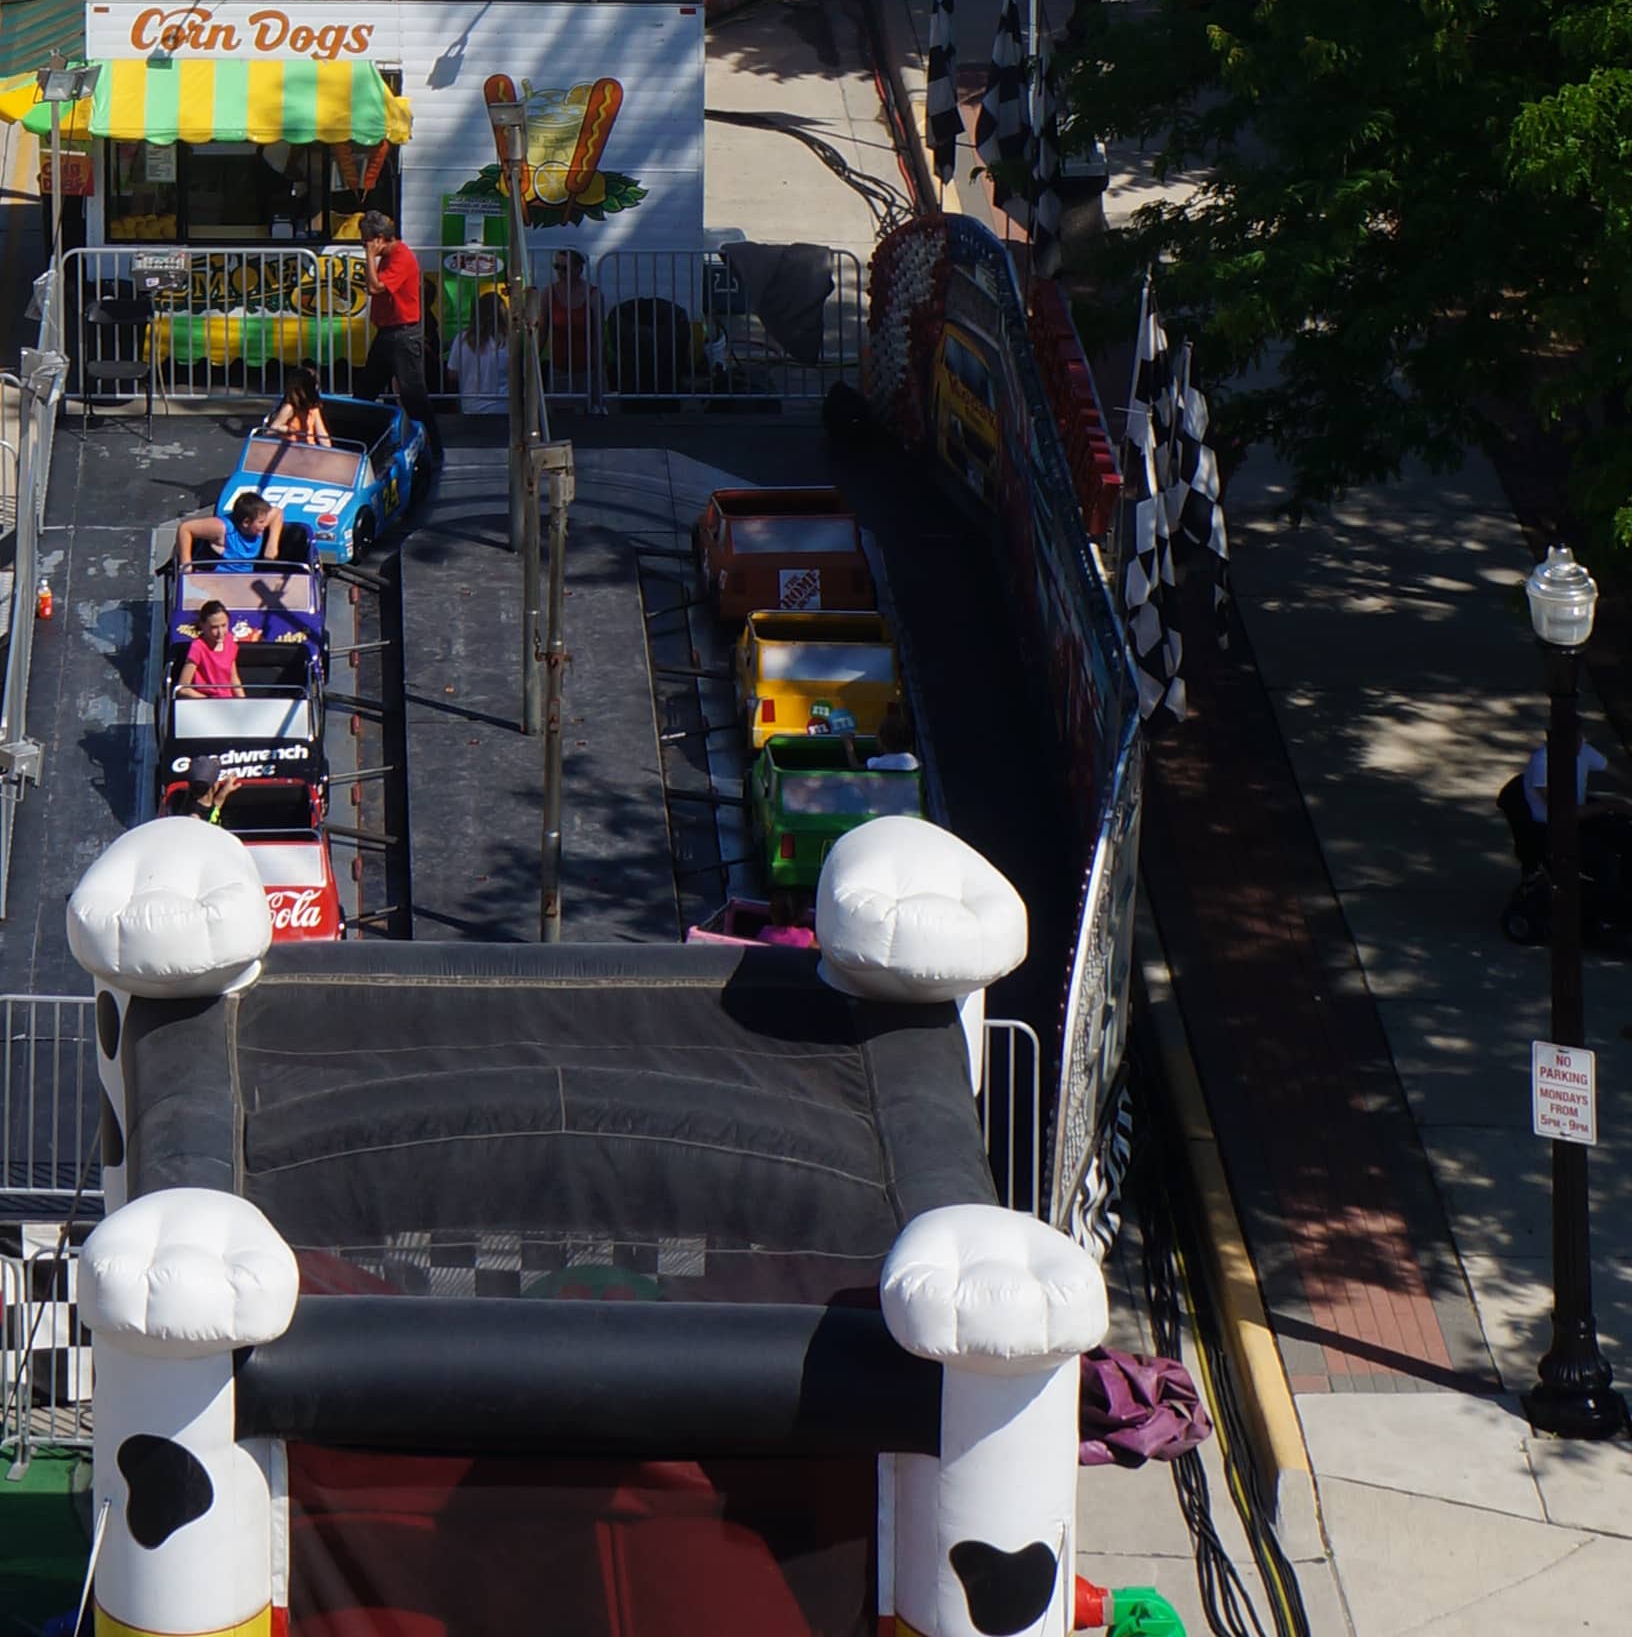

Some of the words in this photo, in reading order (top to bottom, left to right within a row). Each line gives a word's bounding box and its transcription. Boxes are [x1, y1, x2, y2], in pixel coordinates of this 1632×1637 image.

[131, 7, 241, 52] Corn
[249, 10, 374, 61] Dogs
[1555, 1054, 1572, 1067] NO
[1539, 1066, 1588, 1085] PARKING
[1539, 1086, 1589, 1106] MONDAYS
[1550, 1103, 1578, 1117] FROM
[1540, 1114, 1561, 1128] 5PM
[1569, 1118, 1589, 1133] 9PM
